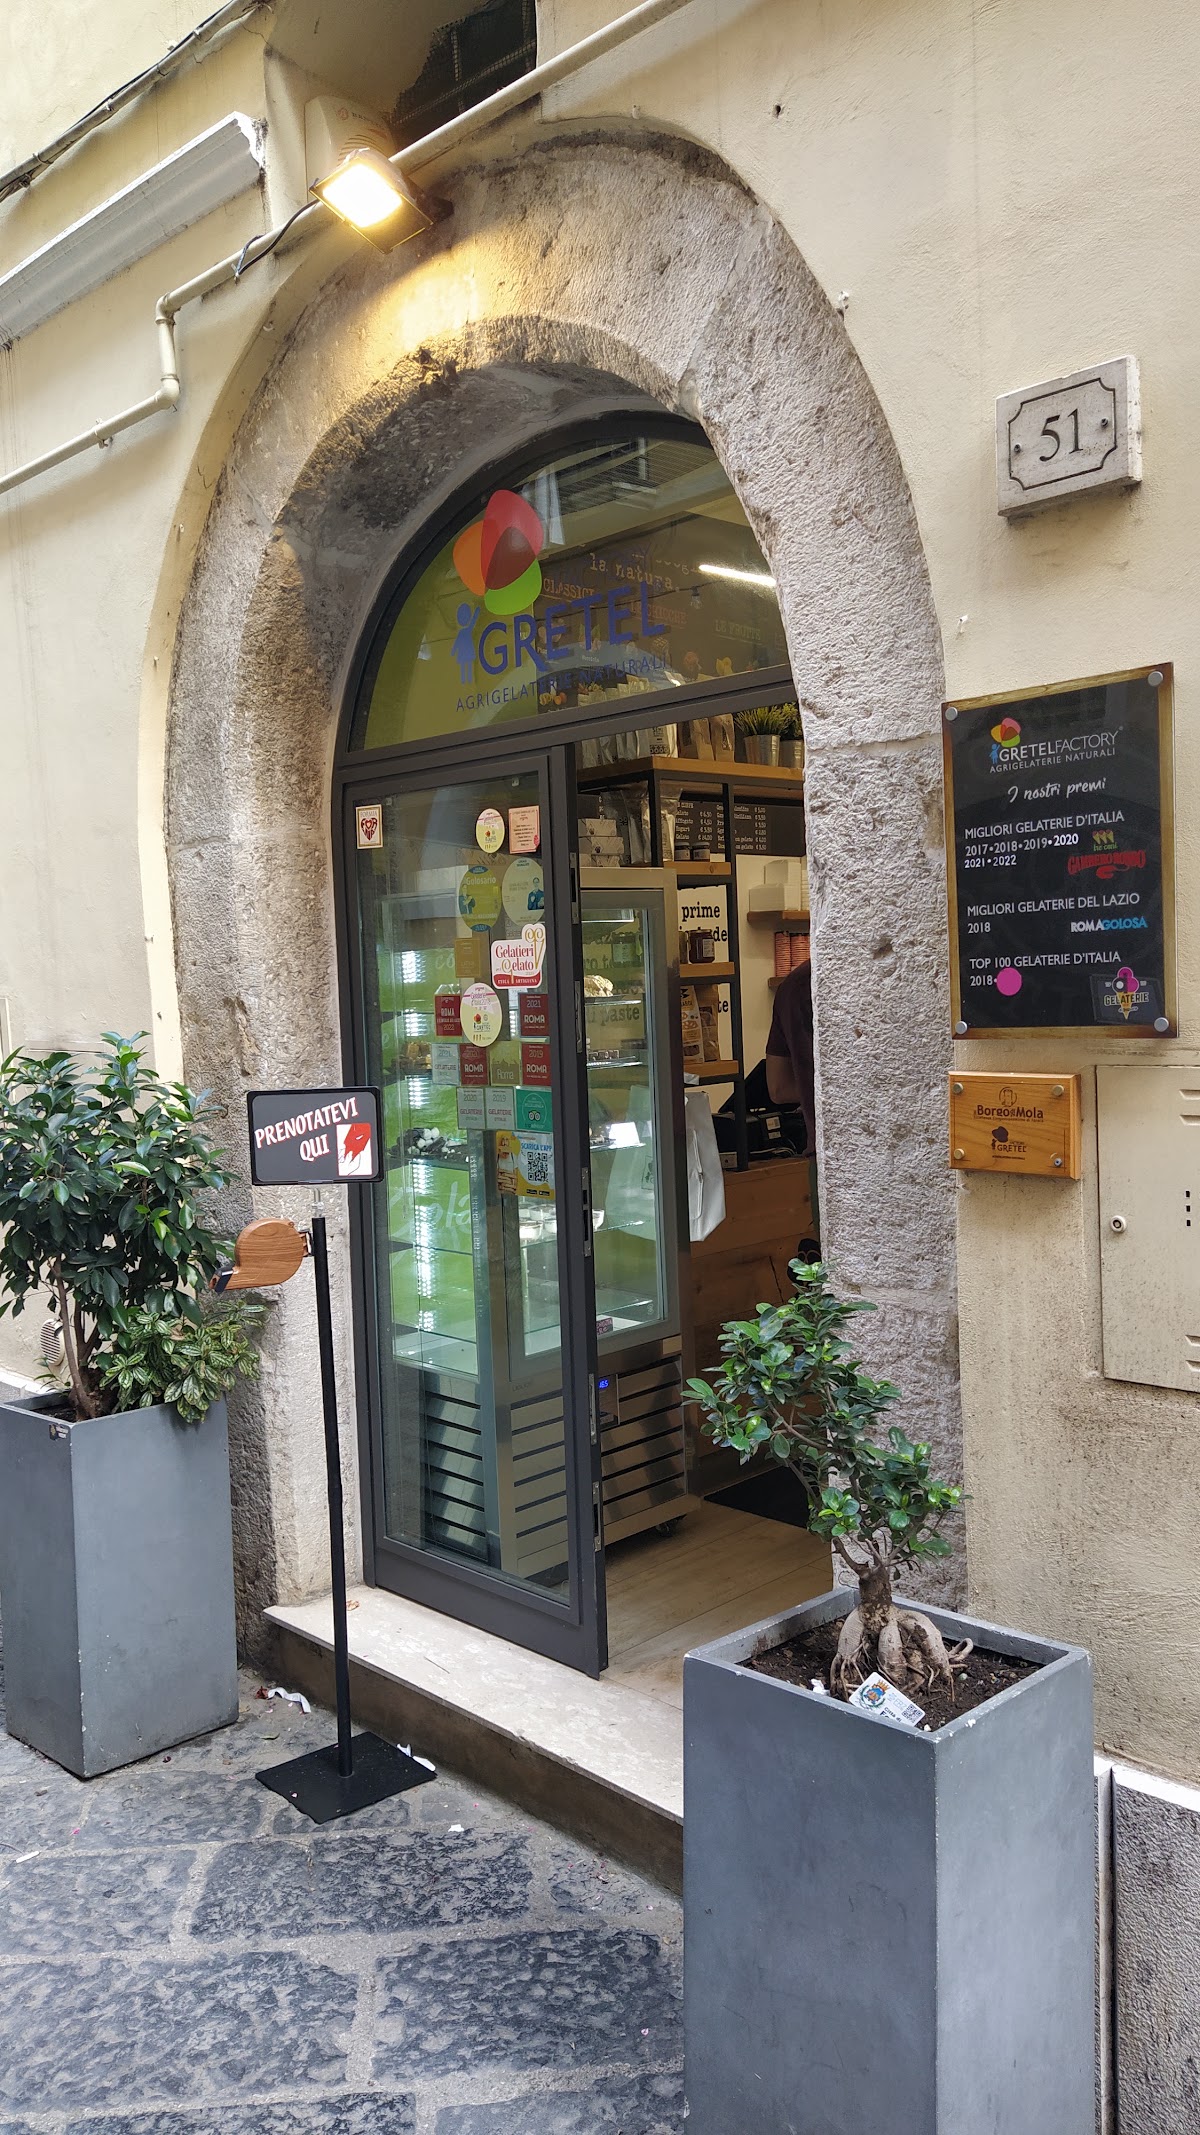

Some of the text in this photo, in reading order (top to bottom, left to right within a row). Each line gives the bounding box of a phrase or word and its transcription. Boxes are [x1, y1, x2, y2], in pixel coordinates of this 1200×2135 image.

[1039, 408, 1083, 462] 51
[478, 581, 665, 676] GRETEL
[581, 655, 666, 687] NATURALI
[990, 747, 1116, 774] AGRIGELATERIE NATURALI
[1024, 783, 1060, 801] nostri
[1066, 777, 1106, 798] premi
[965, 810, 1125, 840] MIGLIORI GELATERIE D'ITALIA
[681, 901, 720, 922] prime
[967, 893, 1140, 917] MIGLIORI GELATERIE DEL LAZIO
[967, 922, 991, 934] 2018
[495, 944, 534, 959] Gelatieri
[969, 951, 1122, 970] TOP 100 GELATERIE D'ITALIA
[1104, 992, 1149, 1006] GELATERIE
[441, 1007, 455, 1017] ROMA
[524, 1014, 545, 1024] ROMA
[529, 1049, 544, 1059] 2019
[464, 1063, 484, 1073] ROMA
[526, 1064, 548, 1074] ROMA
[254, 1096, 359, 1149] PRENOTATEVI
[300, 1134, 330, 1162] QUI
[997, 1144, 1027, 1153] GRETEL
